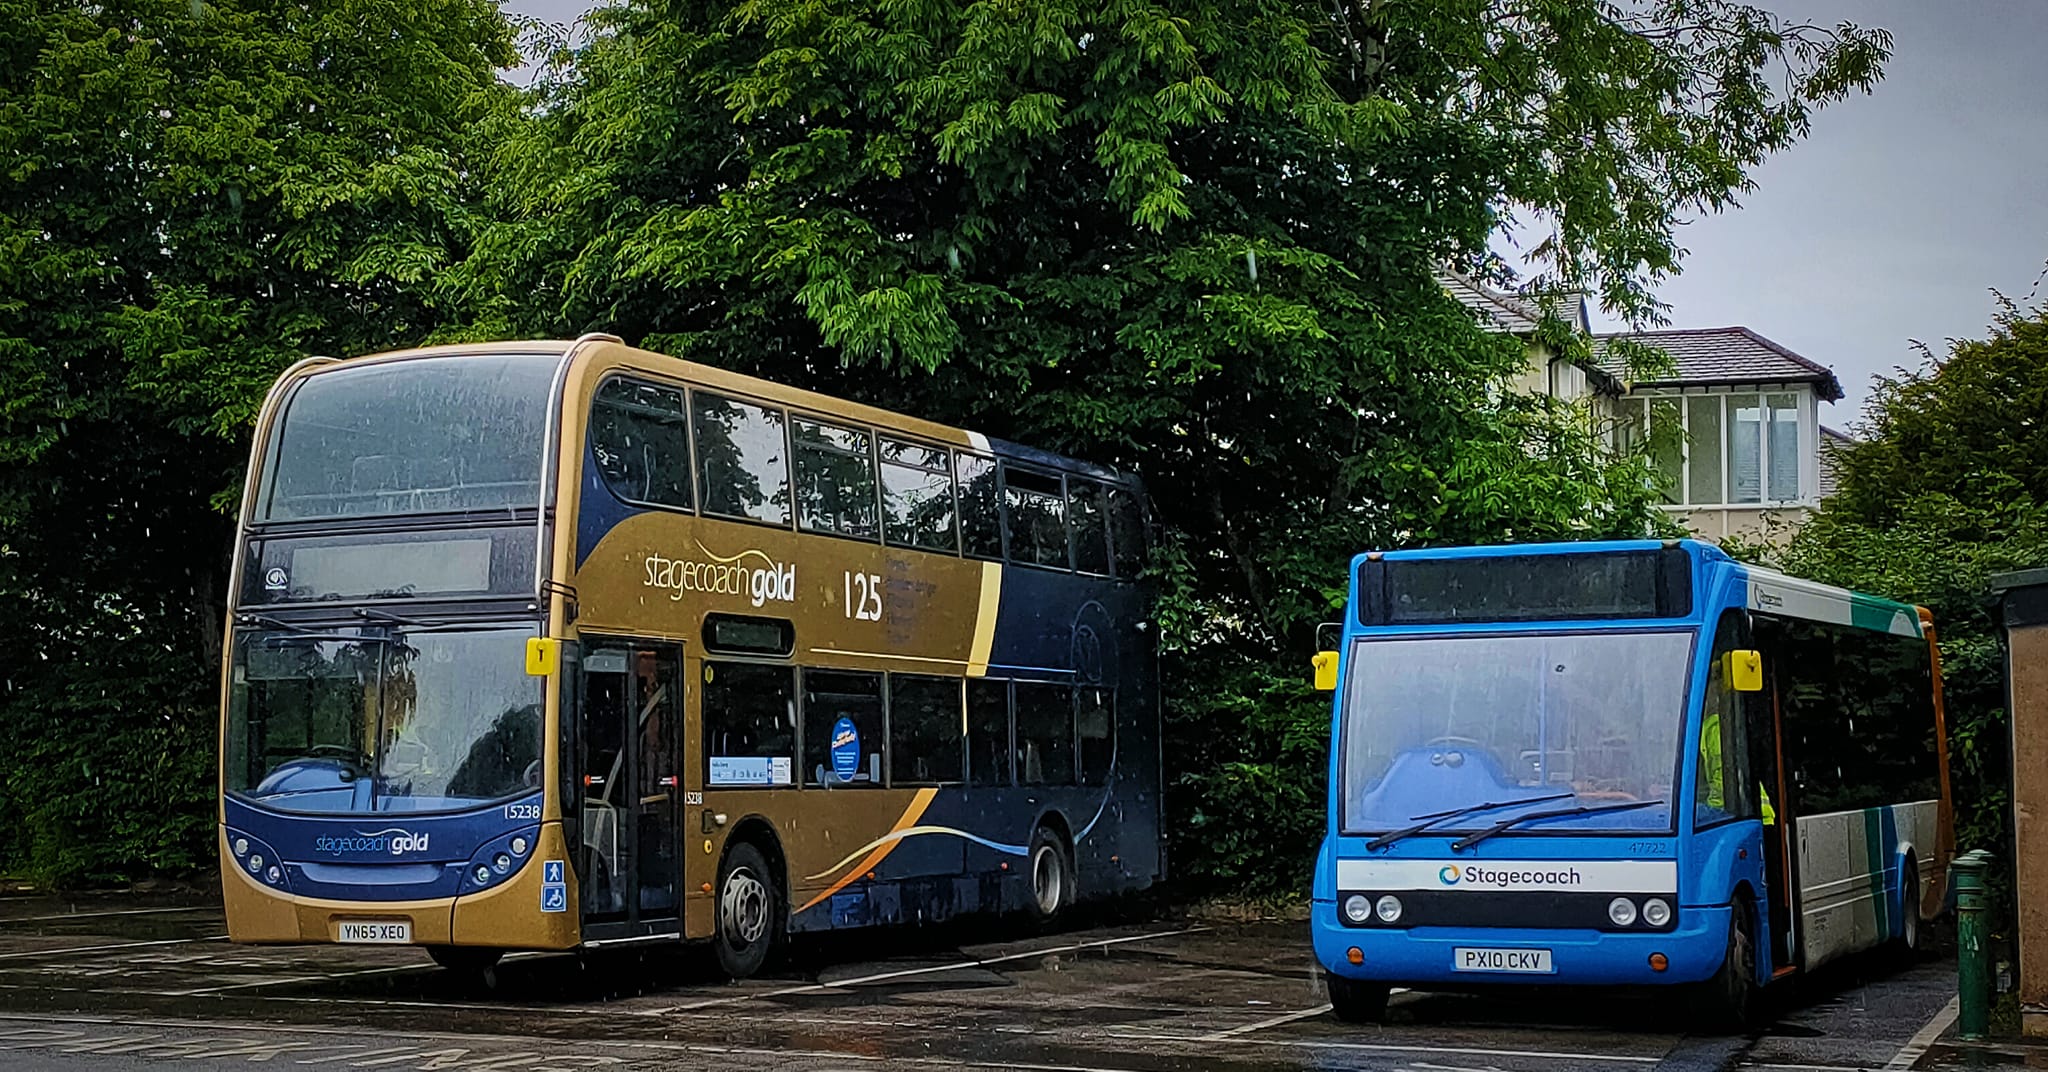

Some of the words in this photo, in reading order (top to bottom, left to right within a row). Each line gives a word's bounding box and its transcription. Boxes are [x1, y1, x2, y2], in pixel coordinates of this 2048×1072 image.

[644, 553, 749, 601] stagecoach
[751, 562, 796, 608] gold
[845, 571, 883, 622] 125
[504, 804, 541, 820] 15238
[315, 834, 391, 856] stagecoach
[391, 832, 429, 855] gold
[1465, 866, 1581, 887] Stagecoach
[343, 925, 377, 940] YN65
[380, 925, 405, 940] XEO
[1465, 951, 1503, 968] PX10
[1508, 952, 1541, 969] CKV
